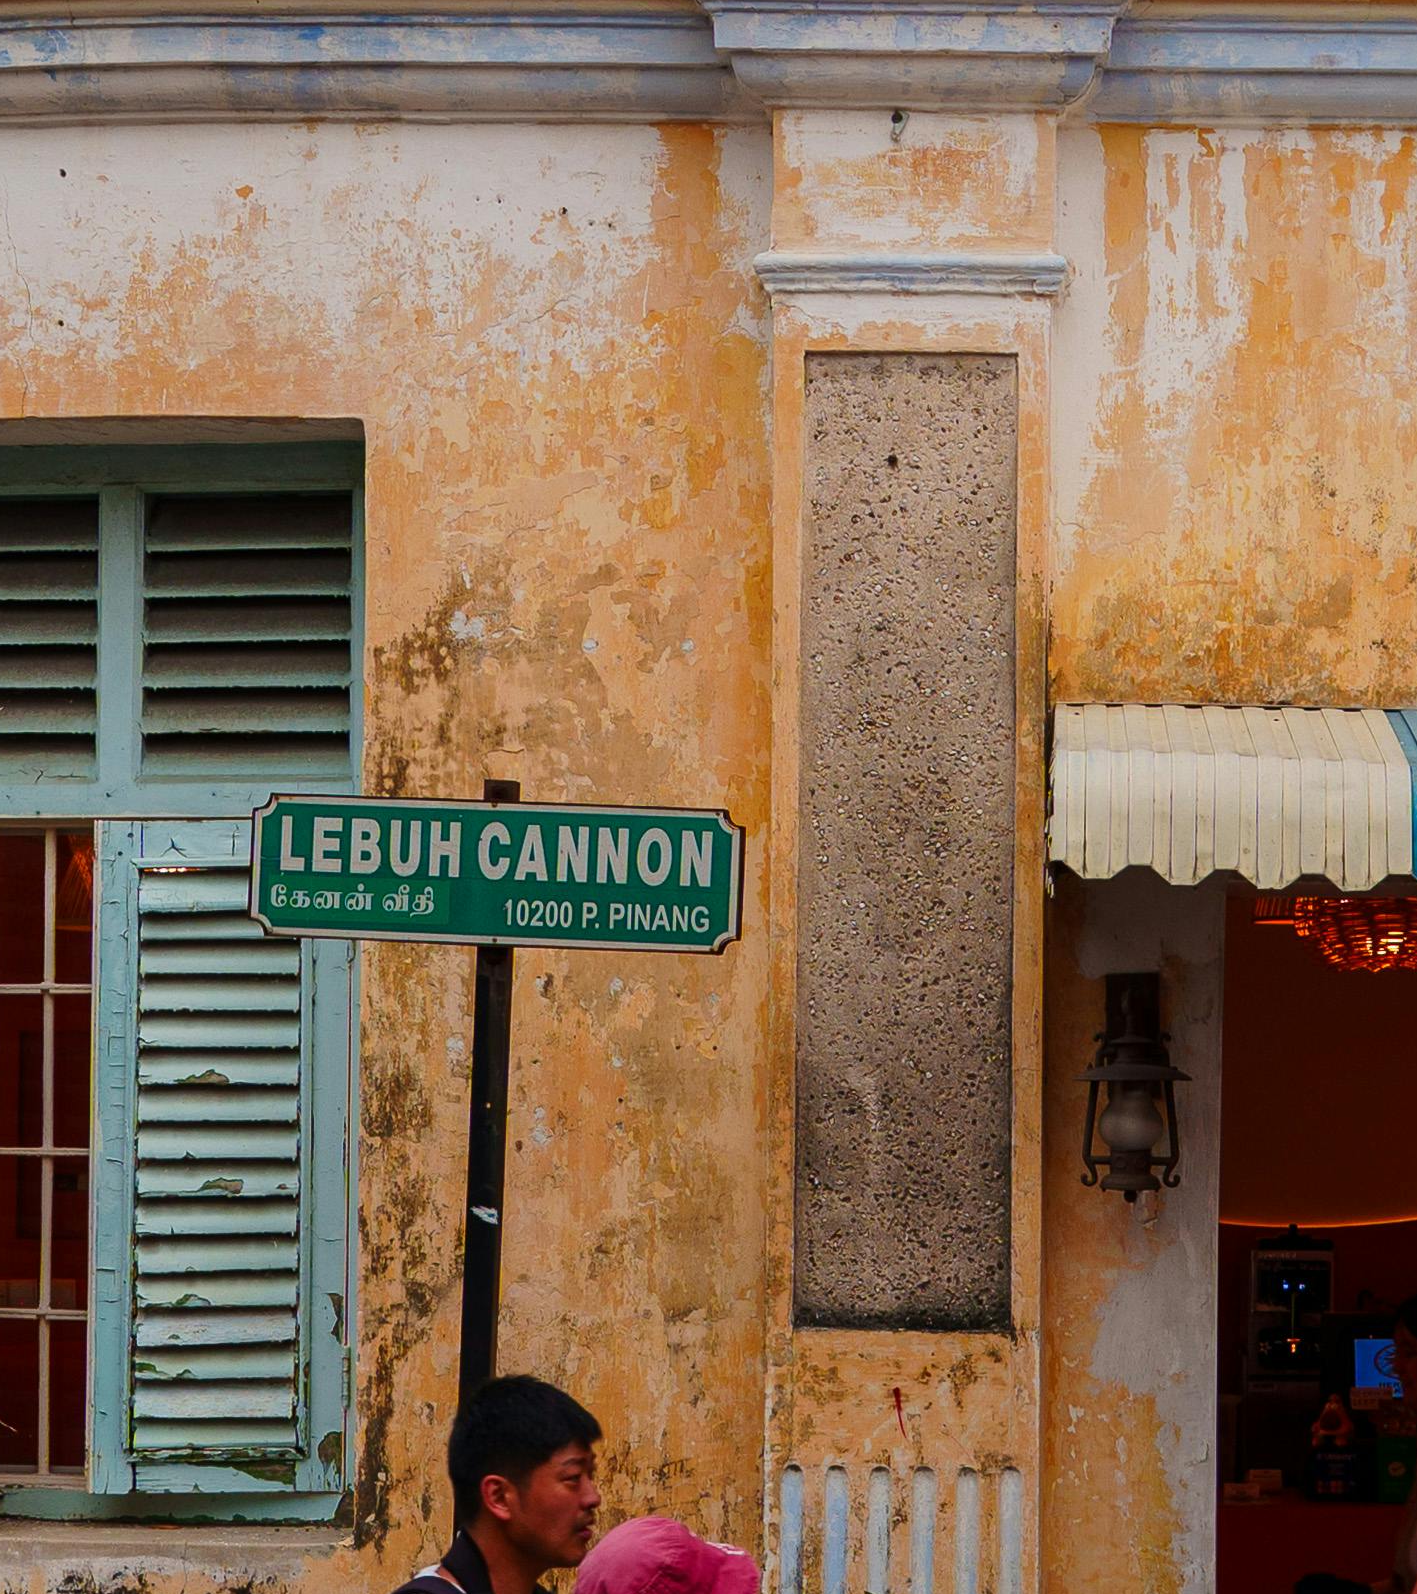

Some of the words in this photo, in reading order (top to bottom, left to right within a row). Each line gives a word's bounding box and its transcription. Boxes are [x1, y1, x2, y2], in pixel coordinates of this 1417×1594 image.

[278, 814, 463, 879] LEBUH
[477, 821, 714, 888] CANNON
[270, 882, 375, 912] கேனன்
[382, 883, 436, 918] வீதி
[504, 898, 573, 929] 10200
[582, 902, 600, 930] P.
[608, 903, 711, 934] PINANG
